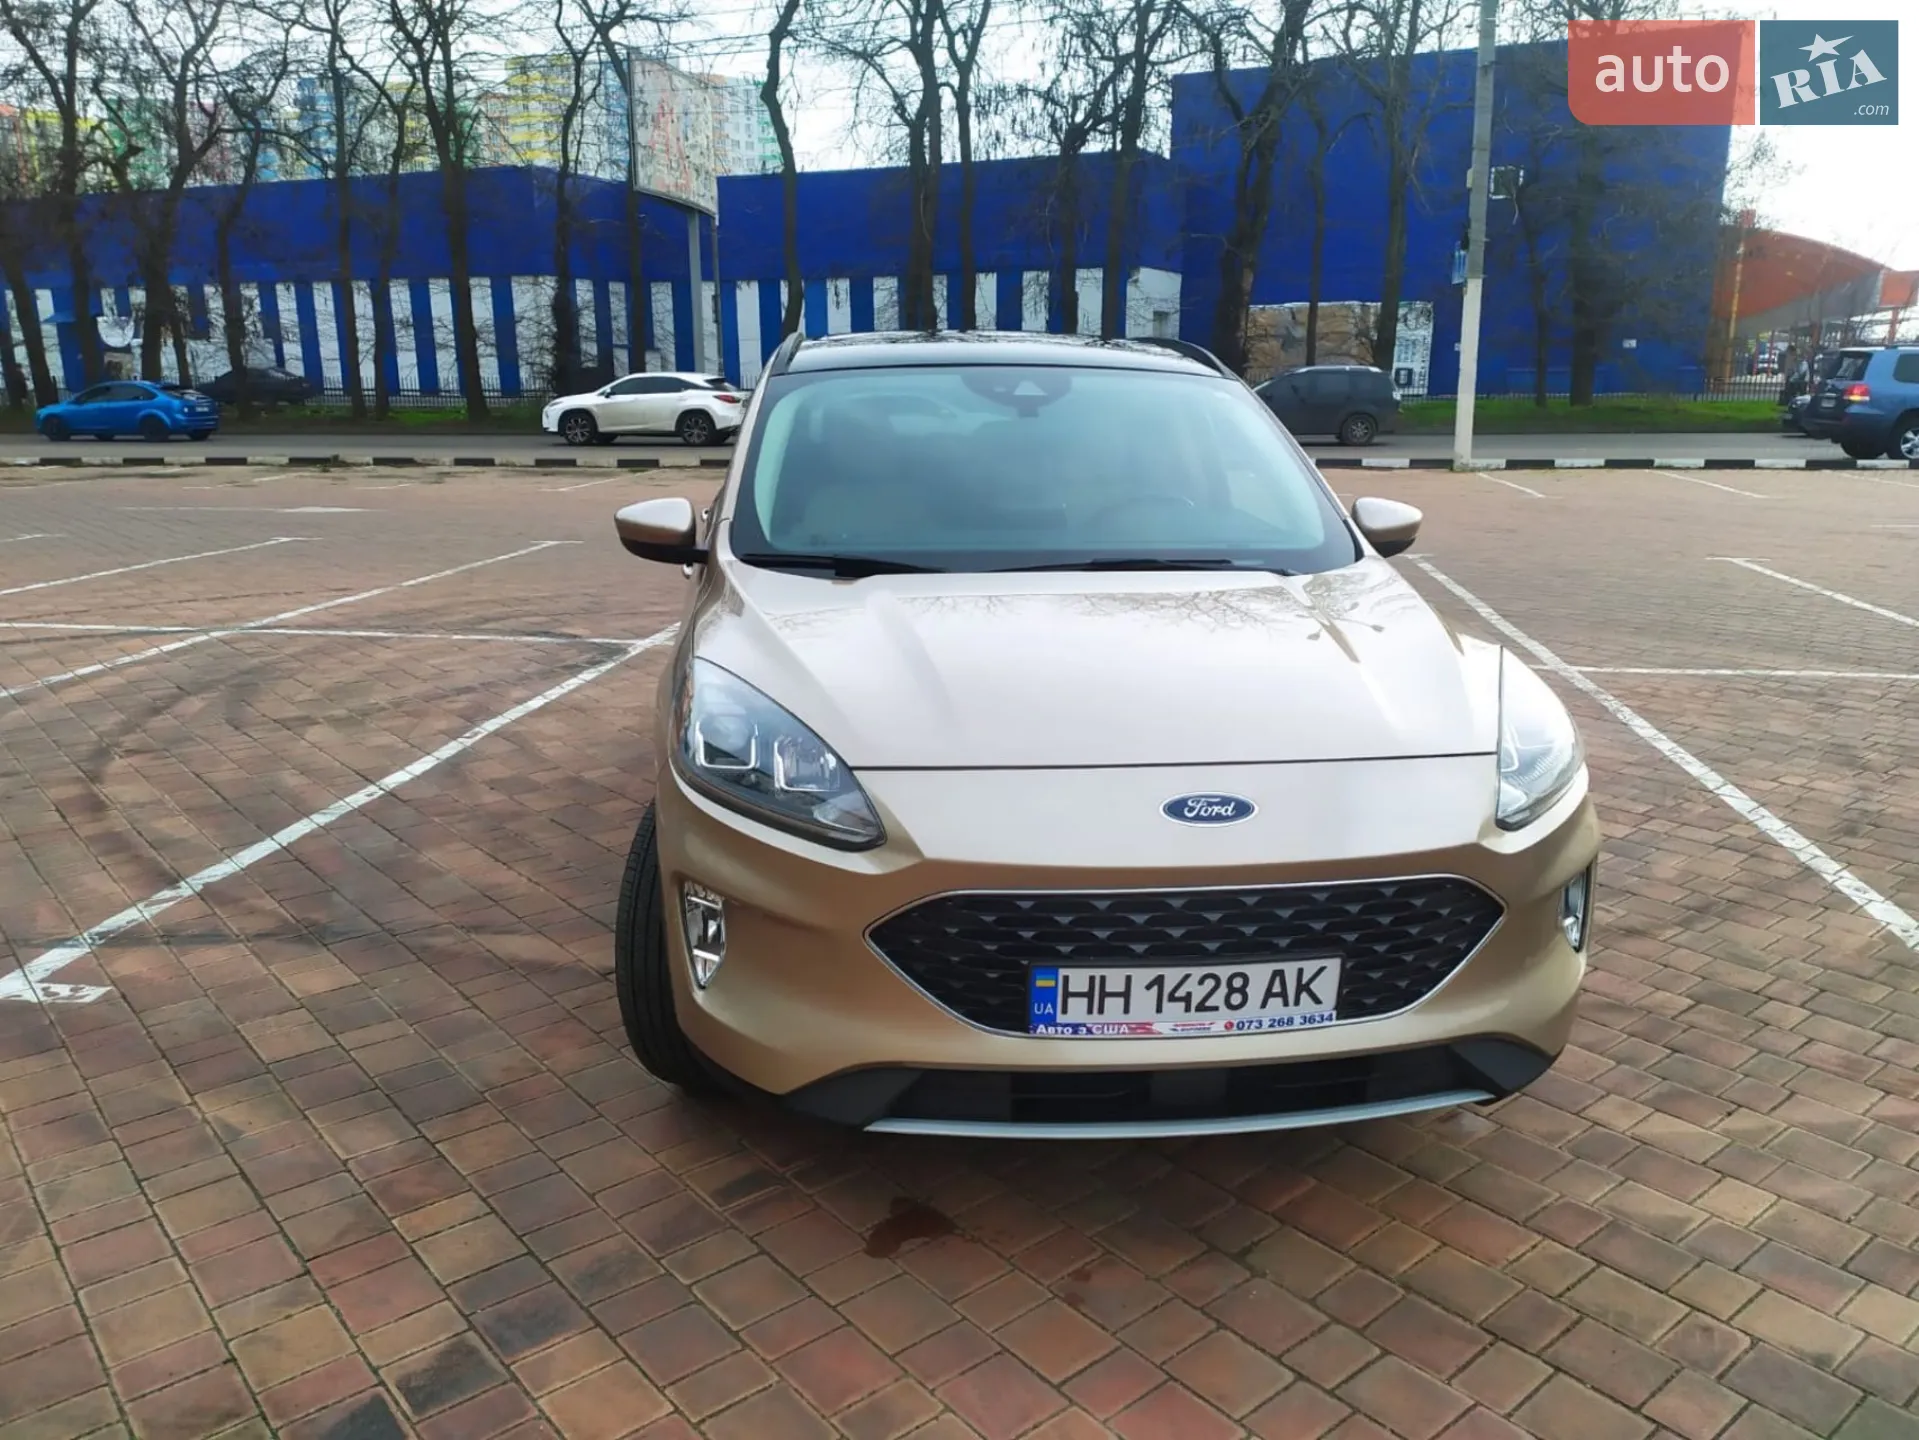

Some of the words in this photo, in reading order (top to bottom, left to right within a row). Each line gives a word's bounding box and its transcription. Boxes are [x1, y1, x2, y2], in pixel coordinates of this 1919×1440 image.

[1184, 798, 1236, 817] Ford
[1061, 974, 1132, 1015] HH
[1145, 972, 1250, 1014] 1428
[1260, 965, 1327, 1008] AK
[1034, 1003, 1054, 1014] UA
[1035, 1023, 1074, 1034] Авто
[1091, 1023, 1129, 1034] США
[1236, 1018, 1264, 1031] 073
[1267, 1016, 1295, 1029] 268
[1299, 1012, 1335, 1026] 3634
